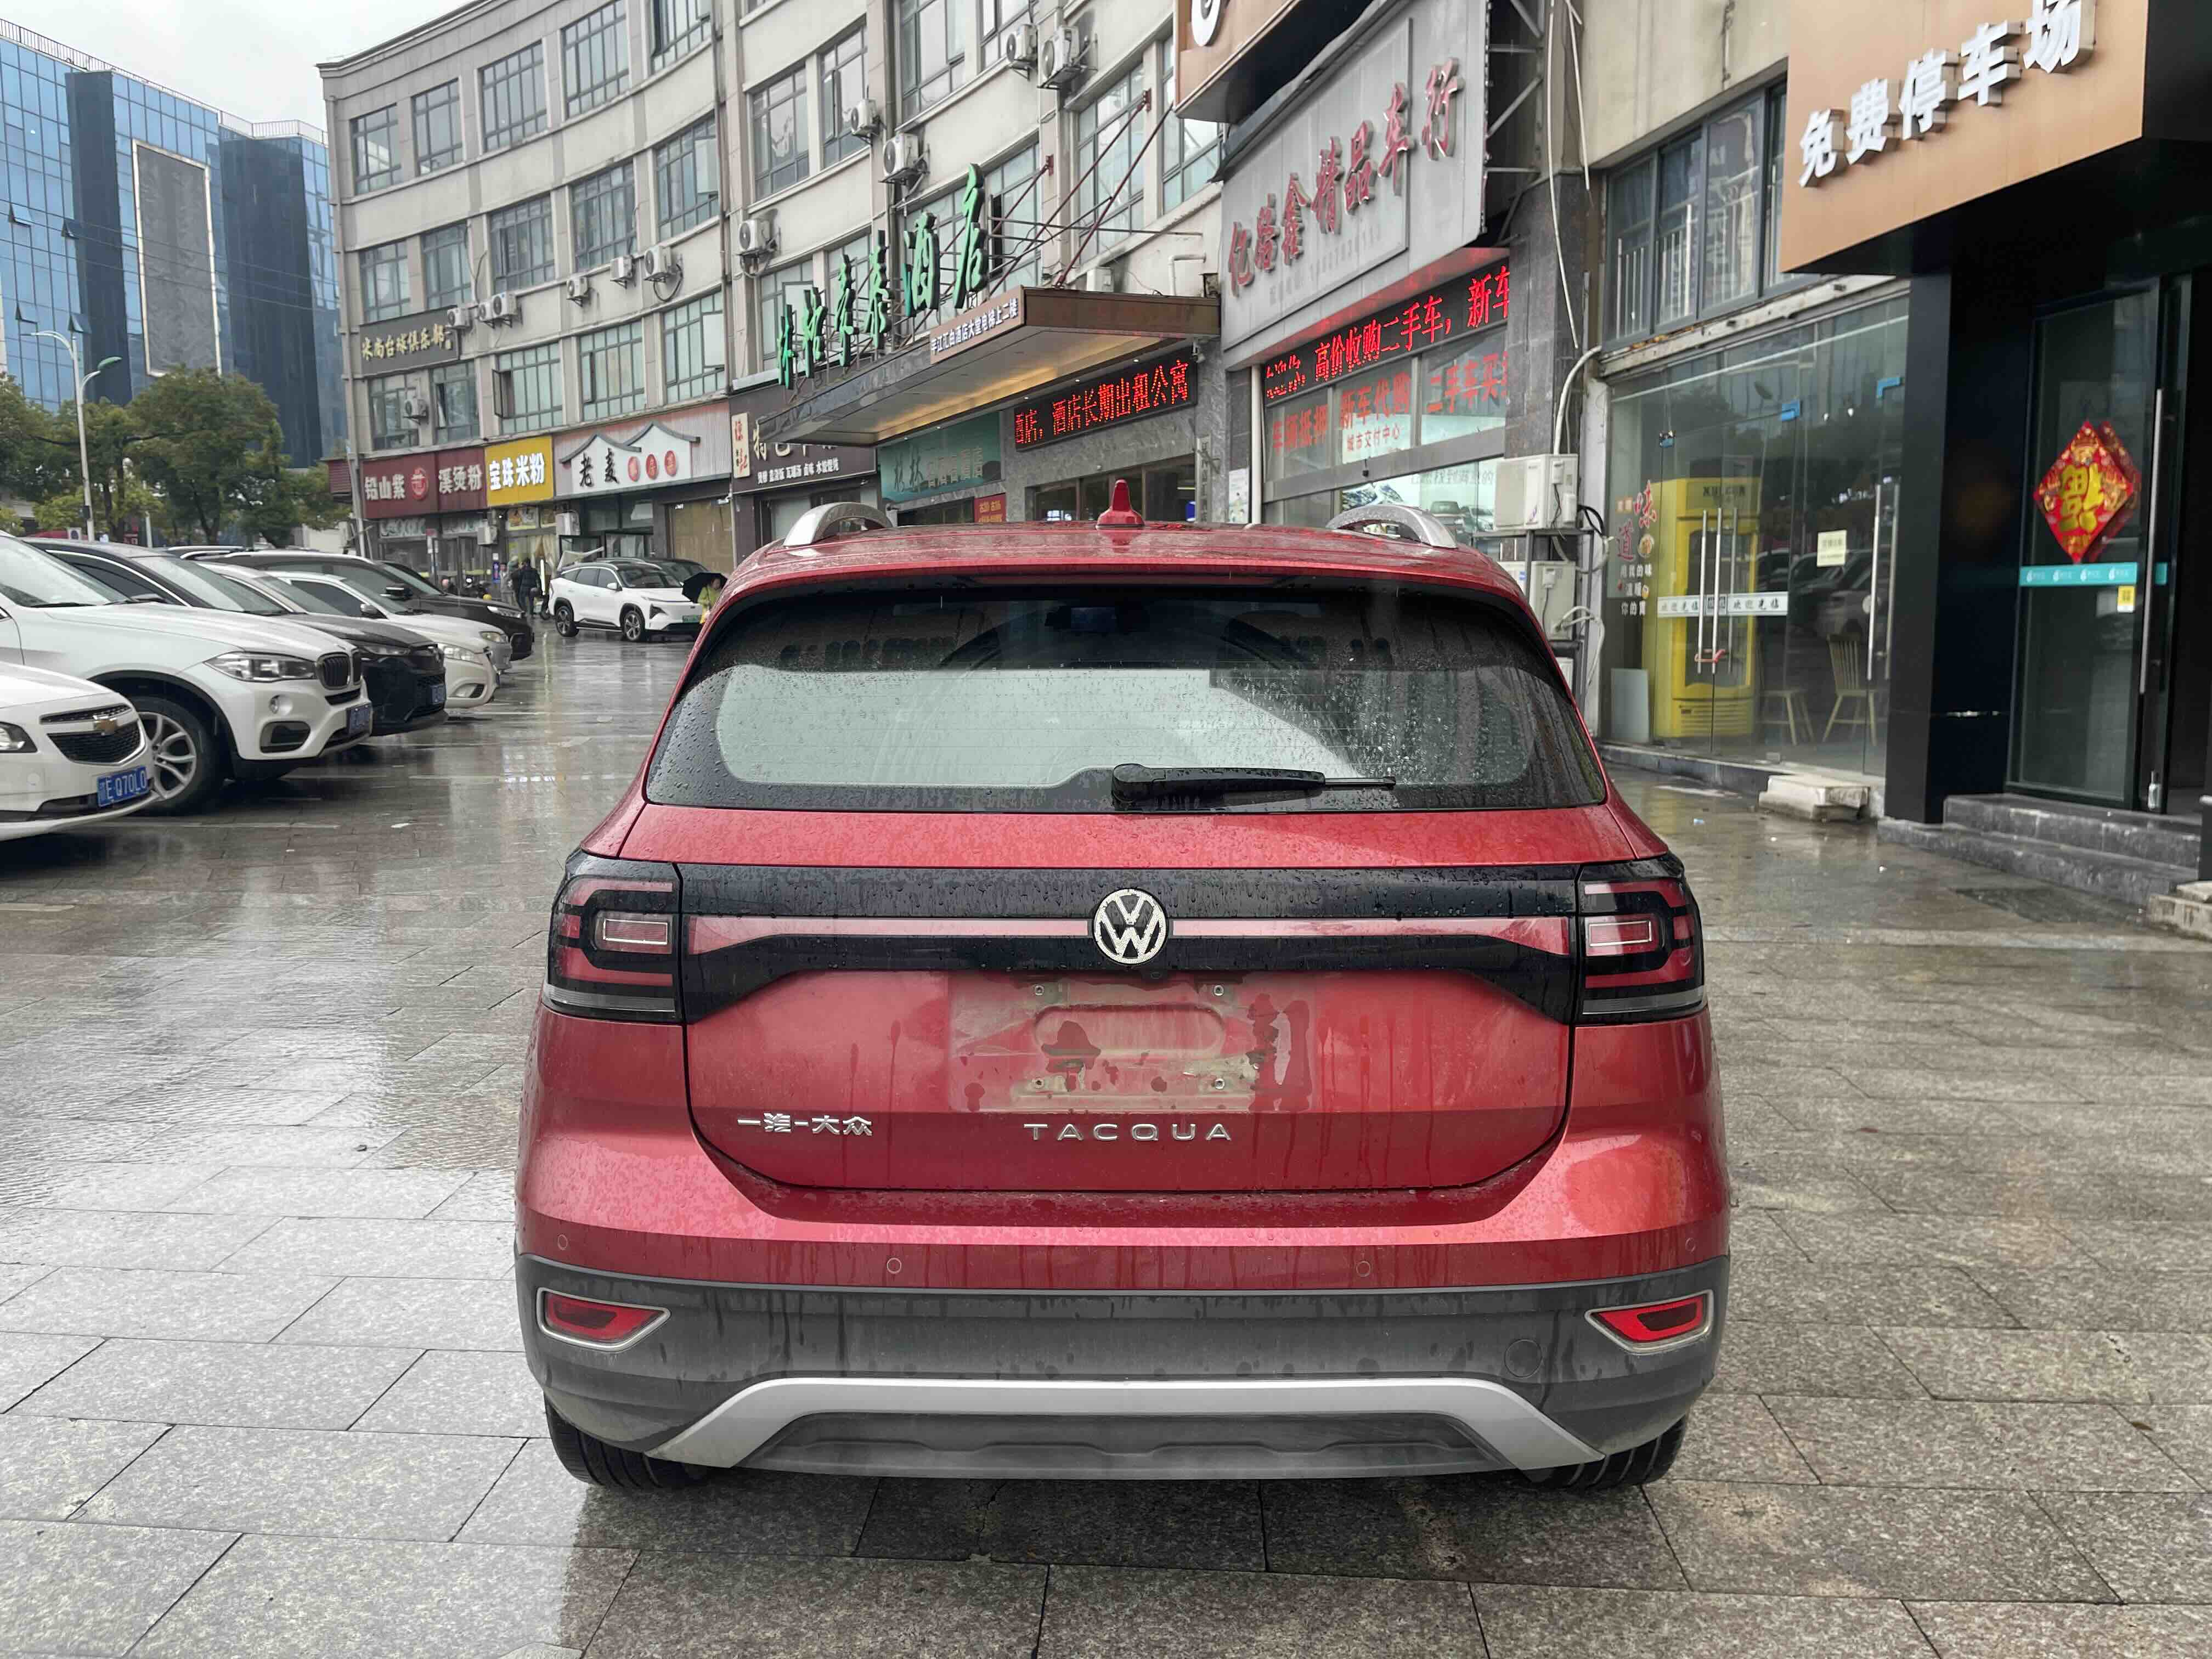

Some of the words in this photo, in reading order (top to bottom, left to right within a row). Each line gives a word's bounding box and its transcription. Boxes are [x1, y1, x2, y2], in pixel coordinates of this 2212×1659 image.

[1799, 0, 2085, 187] 免费停车场
[489, 453, 545, 490] 宝珠米粉
[1734, 597, 1779, 611] 欢迎光临
[737, 1113, 873, 1137] 一汽-大众
[1024, 1122, 1232, 1142] TACQUA
